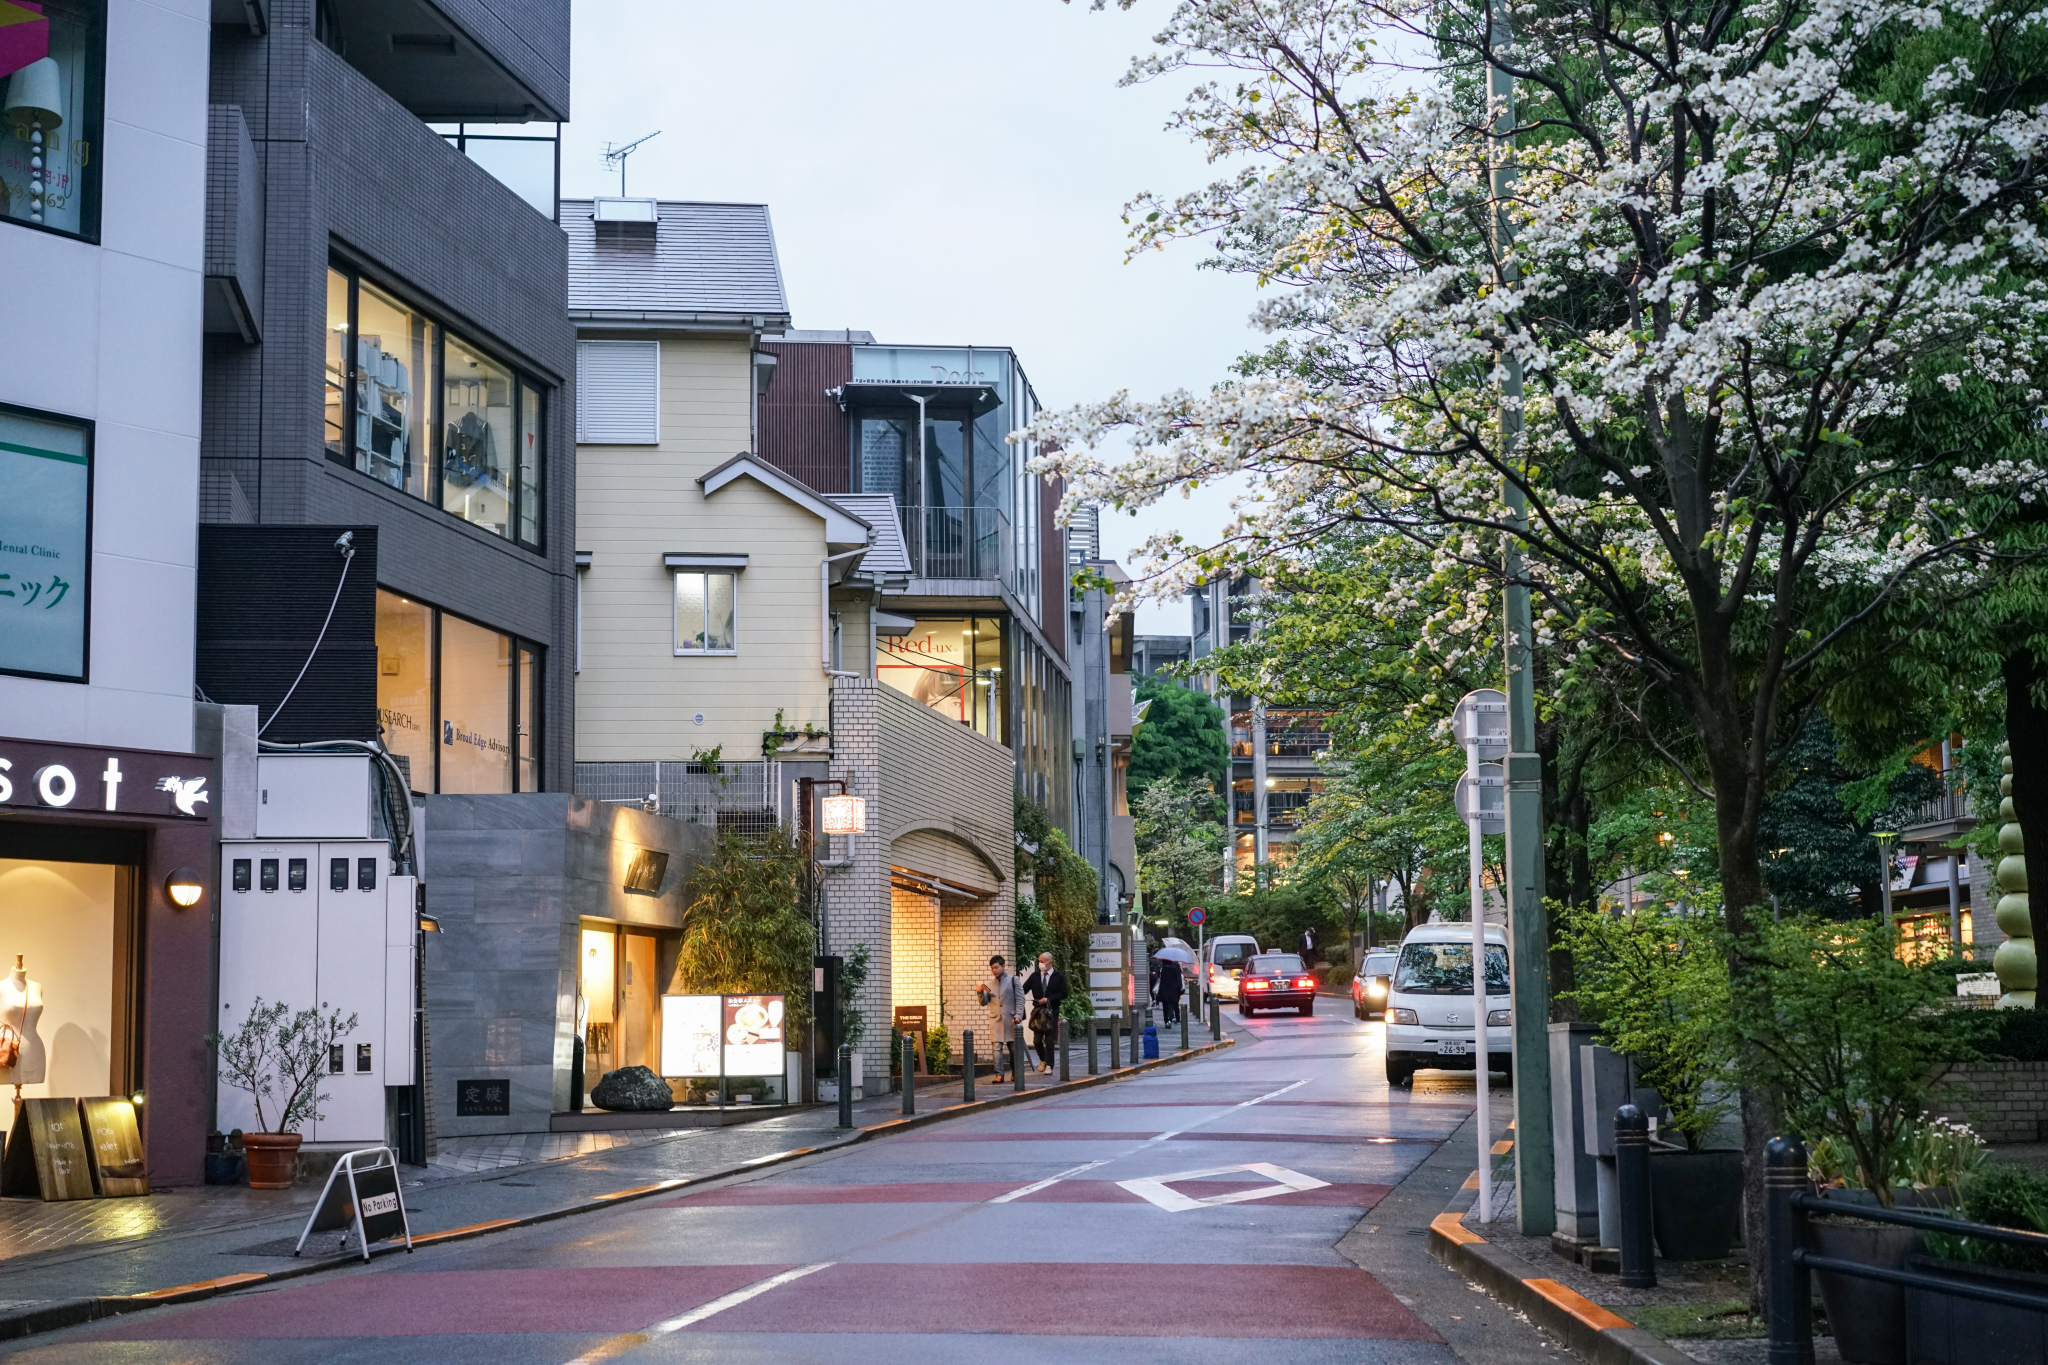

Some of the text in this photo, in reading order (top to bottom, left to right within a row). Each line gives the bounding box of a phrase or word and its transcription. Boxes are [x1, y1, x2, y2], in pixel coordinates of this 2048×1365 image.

[930, 365, 985, 384] Door
[31, 545, 60, 559] Clinic
[456, 728, 473, 744] Broad
[474, 733, 487, 751] Edge
[465, 1086, 503, 1102] 定礎
[363, 1197, 397, 1213] No Parking
